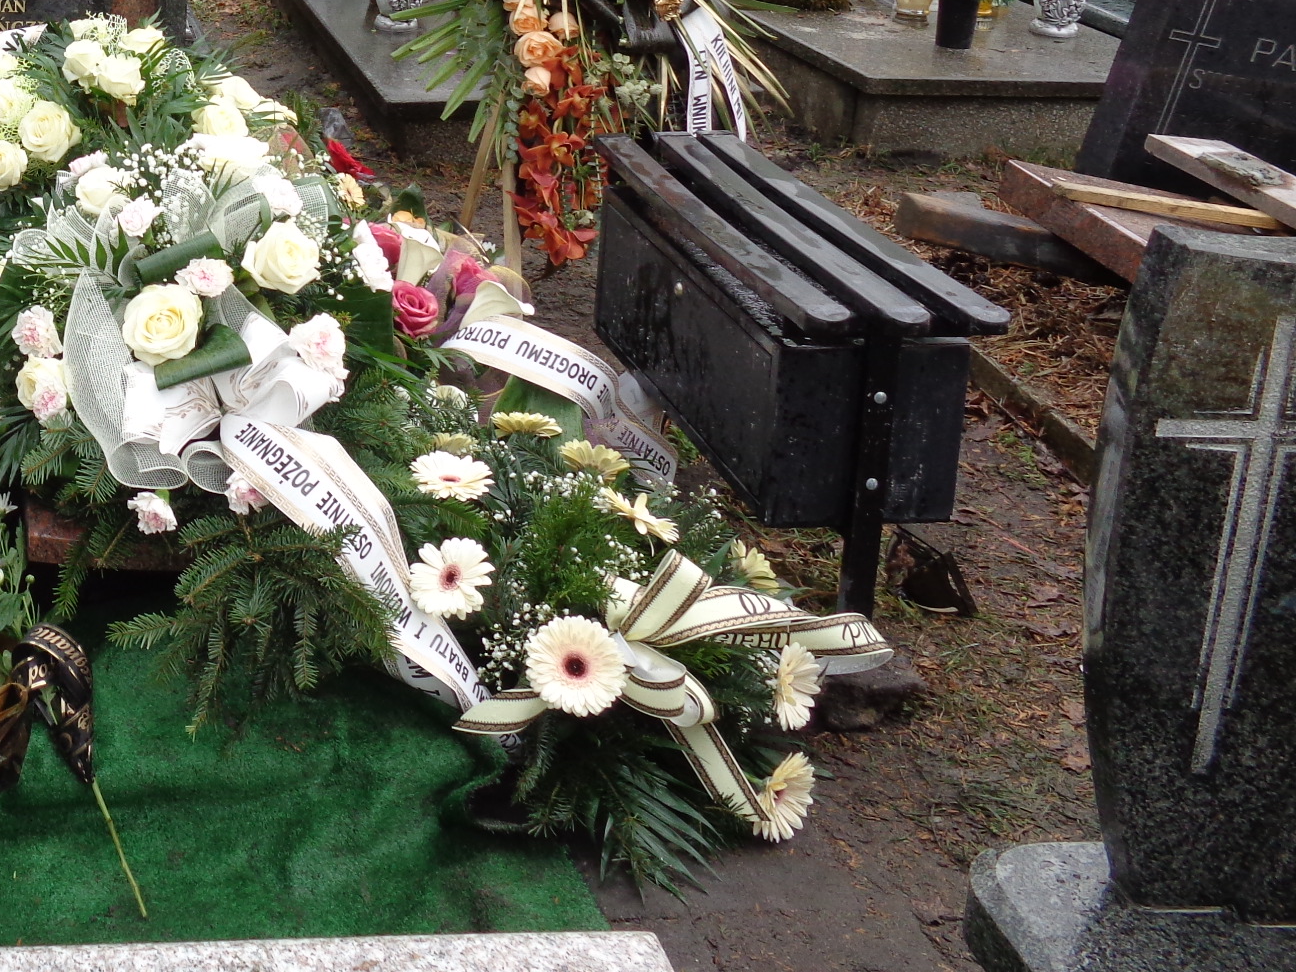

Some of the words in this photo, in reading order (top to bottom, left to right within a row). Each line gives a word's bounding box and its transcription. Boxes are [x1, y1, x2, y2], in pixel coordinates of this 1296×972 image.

[515, 340, 599, 391] DROGIEMU
[234, 421, 320, 497] POŻEGNANIE
[429, 632, 470, 683] BRATU
